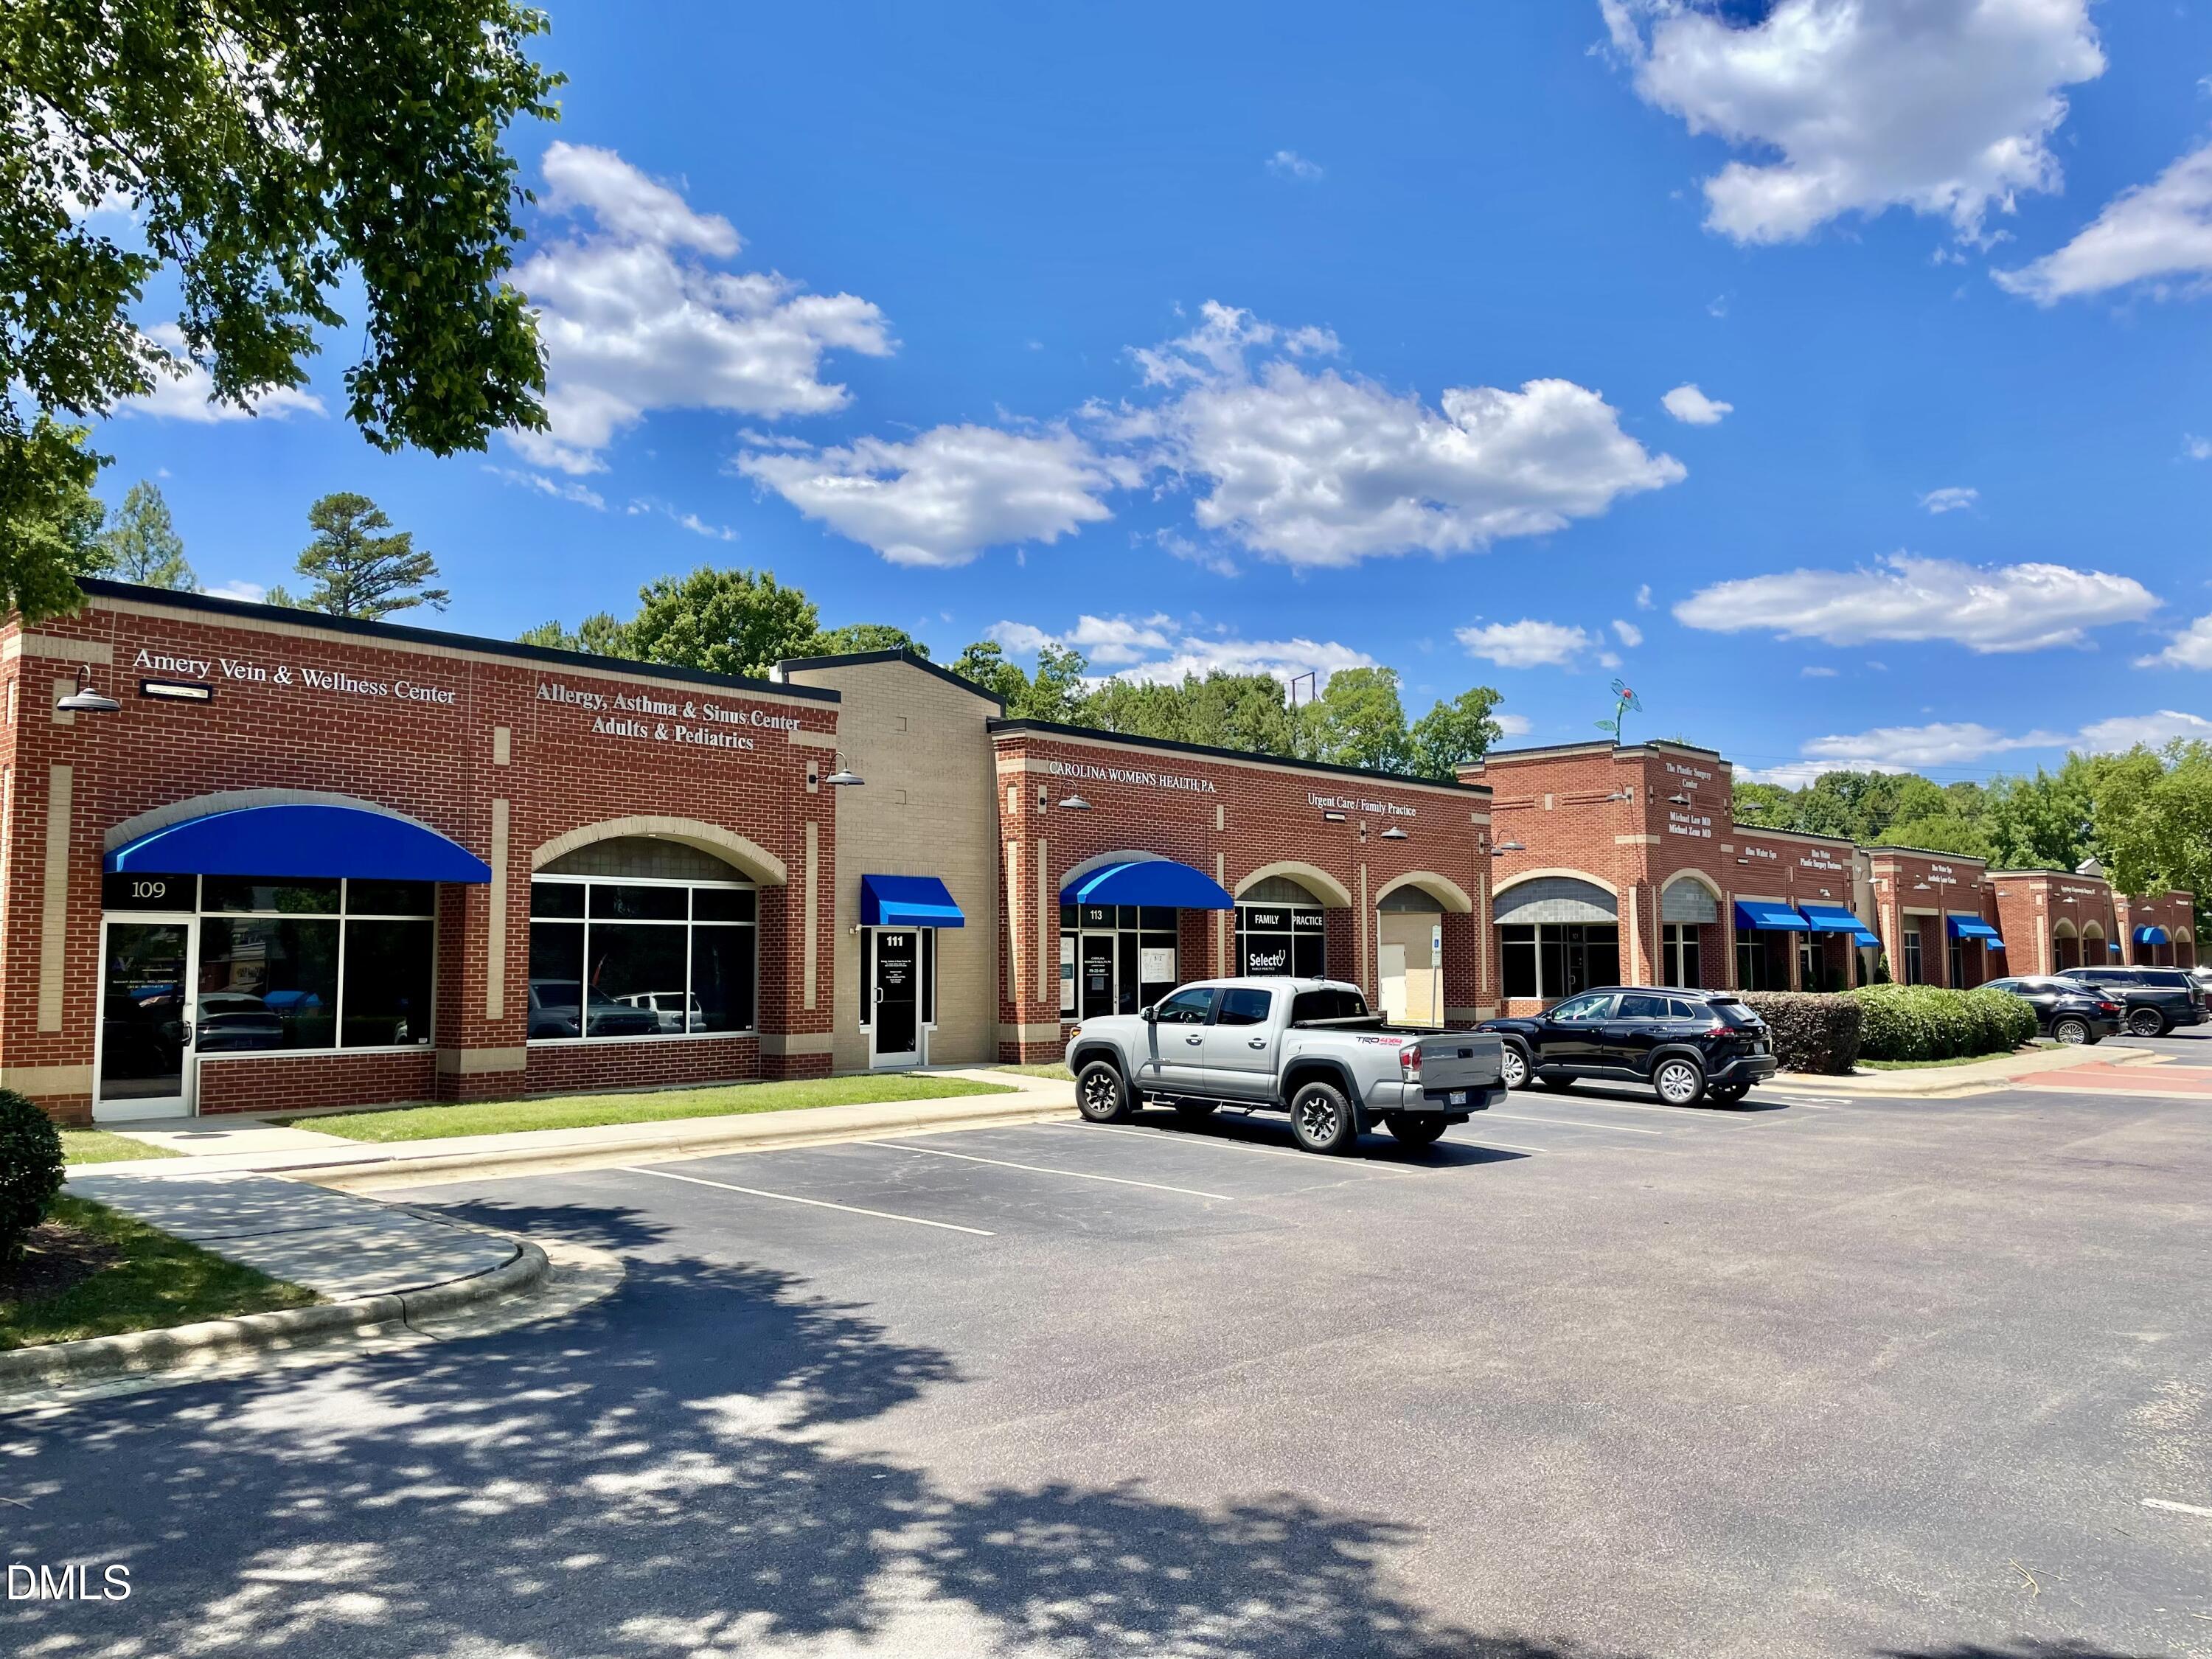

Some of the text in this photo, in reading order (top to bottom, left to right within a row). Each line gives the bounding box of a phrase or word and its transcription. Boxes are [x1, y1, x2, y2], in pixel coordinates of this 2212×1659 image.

[132, 648, 456, 704] Amery Vein & Wellness Center
[535, 682, 800, 731] Allergy, Asthma & Sinus Center
[591, 715, 754, 750] Adults & Pediatrics
[1049, 761, 1217, 793] CAROLINA WOMEN'S HEALTH, P.A.
[1307, 793, 1335, 809] Urgent
[1336, 796, 1354, 809] Care
[1360, 799, 1386, 815] Family
[1388, 802, 1416, 816] Practice
[132, 881, 166, 898] 109
[1090, 909, 1102, 920] 113
[1255, 914, 1323, 925] FAMILY PRACTICE
[886, 936, 902, 947] 111
